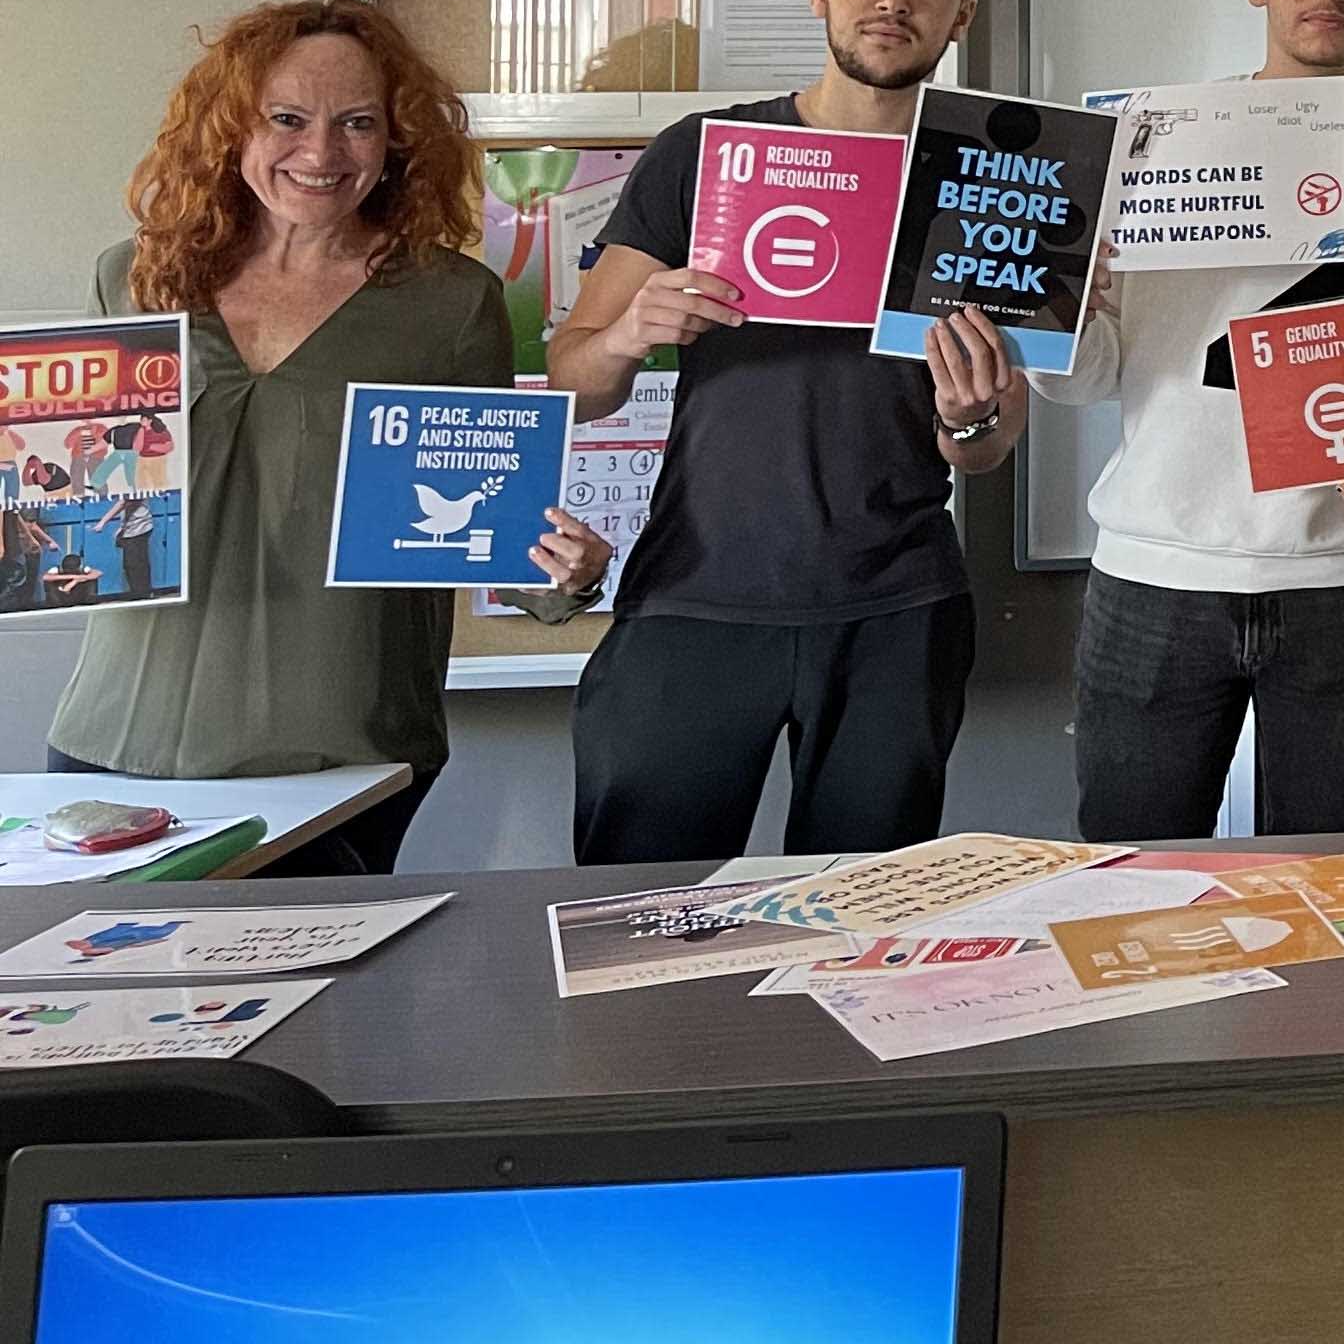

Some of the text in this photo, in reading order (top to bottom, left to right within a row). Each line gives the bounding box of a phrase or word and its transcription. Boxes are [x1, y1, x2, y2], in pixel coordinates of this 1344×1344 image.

[1249, 104, 1279, 115] Loser
[1295, 101, 1320, 114] Ugly
[1277, 116, 1302, 127] Idiot
[718, 142, 755, 183] 10
[766, 146, 832, 168] REDUCED
[957, 147, 1066, 189] THINK
[1121, 166, 1263, 187] WORDS CAN BE
[764, 168, 859, 192] INEQUALITIES
[937, 180, 1070, 225] BEFORE
[1119, 195, 1264, 216] MORE HURTFUL
[960, 219, 1037, 256] YOU
[1111, 224, 1272, 244] THAN WEAPONS.
[932, 252, 1049, 294] SPEAK
[931, 297, 942, 305] BE
[983, 304, 1000, 312] FOR
[1286, 321, 1337, 343] GENDER
[1251, 331, 1273, 368] 5
[8, 391, 179, 418] BULLYING
[369, 406, 409, 446] 16
[477, 409, 540, 428] JUSTICE
[418, 429, 514, 448] AND STRONG
[416, 451, 520, 471] INSTITUTIONS
[577, 455, 648, 472] 2 3 4
[577, 485, 650, 502] 9 10 11
[602, 516, 621, 532] 17
[952, 945, 986, 958] STOP
